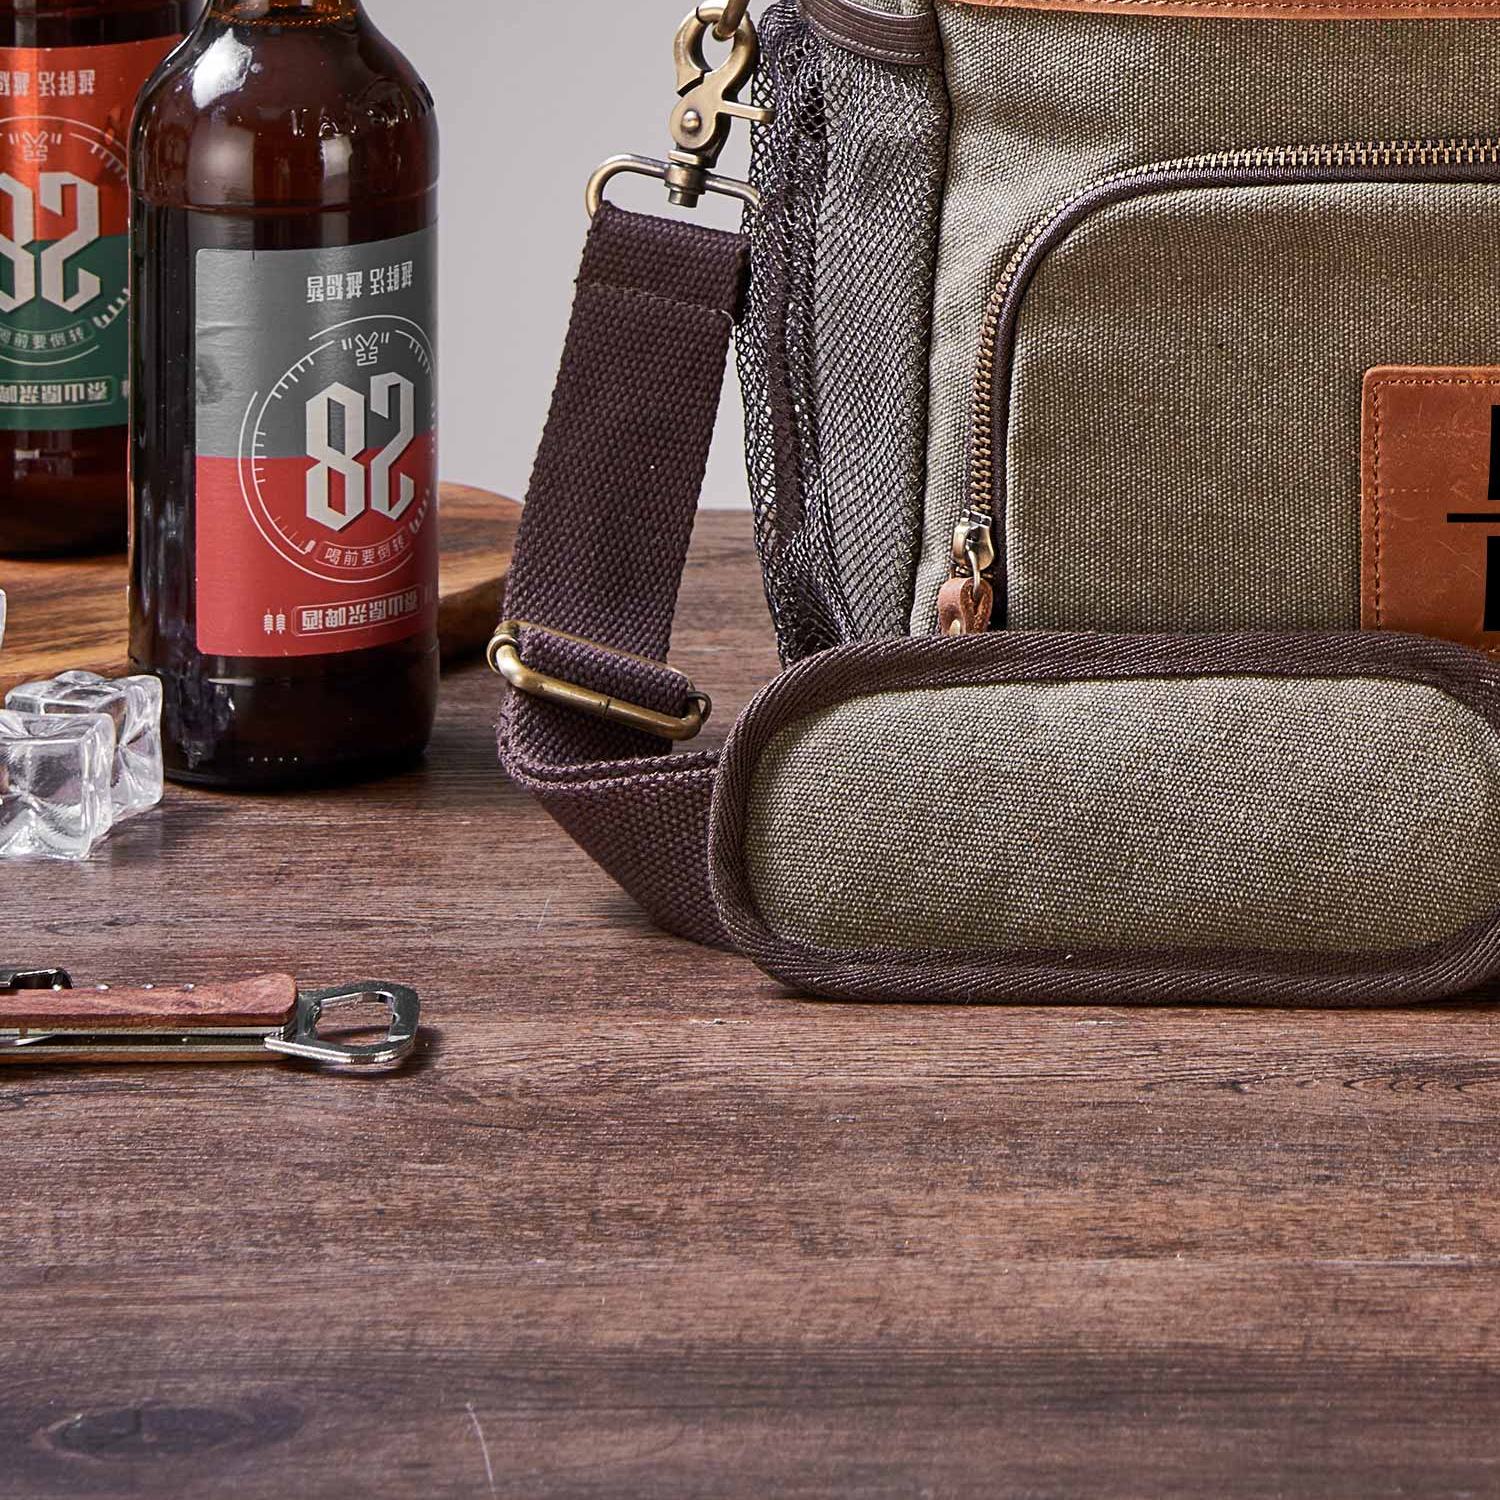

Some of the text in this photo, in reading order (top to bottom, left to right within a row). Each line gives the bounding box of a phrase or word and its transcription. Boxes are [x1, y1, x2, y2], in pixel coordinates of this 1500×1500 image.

[306, 260, 413, 303] 越鲜活 越短暂
[324, 535, 404, 566] 喝前要倒转
[301, 590, 418, 631] 泰山原浆啤酒
